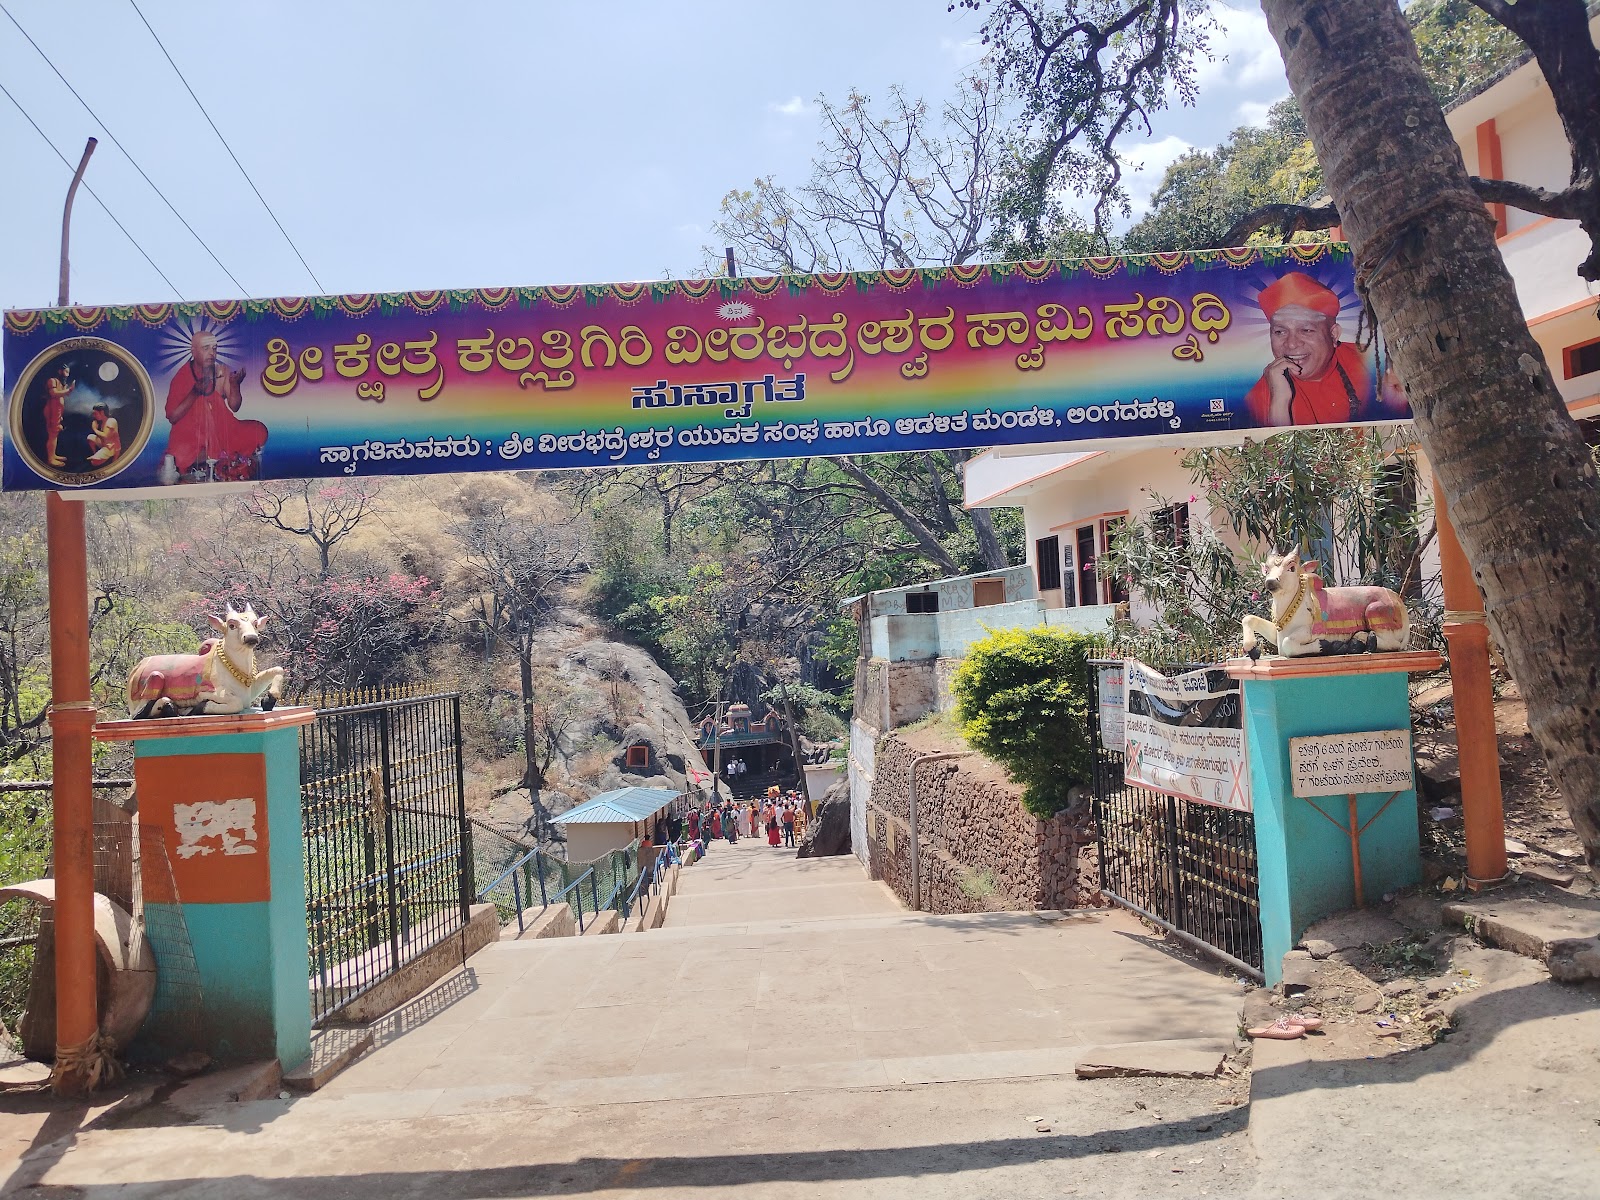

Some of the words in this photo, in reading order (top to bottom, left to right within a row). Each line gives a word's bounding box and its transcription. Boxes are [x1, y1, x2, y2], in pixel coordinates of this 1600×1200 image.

[261, 336, 325, 397] ಶ್ರೀ
[333, 330, 445, 402] ಕ್ಷೇತ್ರ
[456, 324, 653, 392] ಕಲ್ಲತ್ತಿಗಿರಿ
[664, 306, 957, 383] ವೀರಭದ್ರೇಶ್ವರ
[965, 301, 1094, 371] ಸ್ವಾಮಿ
[1104, 291, 1233, 362] ಸನ್ನಿಧಿ
[319, 434, 481, 475] ಸ್ವಾಗತಿಸುವವರು
[498, 432, 534, 461] ಶ್ರೀ
[538, 425, 674, 462] ವೀರಭದ್ರೇಶ್ವರ
[678, 421, 760, 448] ಯುವಕ
[763, 418, 820, 445] ಸಂಘ
[823, 414, 890, 438] ಹಾಗೂ
[894, 409, 968, 436] ಆಡಳಿತ
[971, 405, 1062, 432] ಮಂಡಳಿ,
[1066, 396, 1183, 430] ಲಿಂಗದಹಳ್ಳಿ
[630, 373, 807, 420] ಸುಸ್ವಾಗತ
